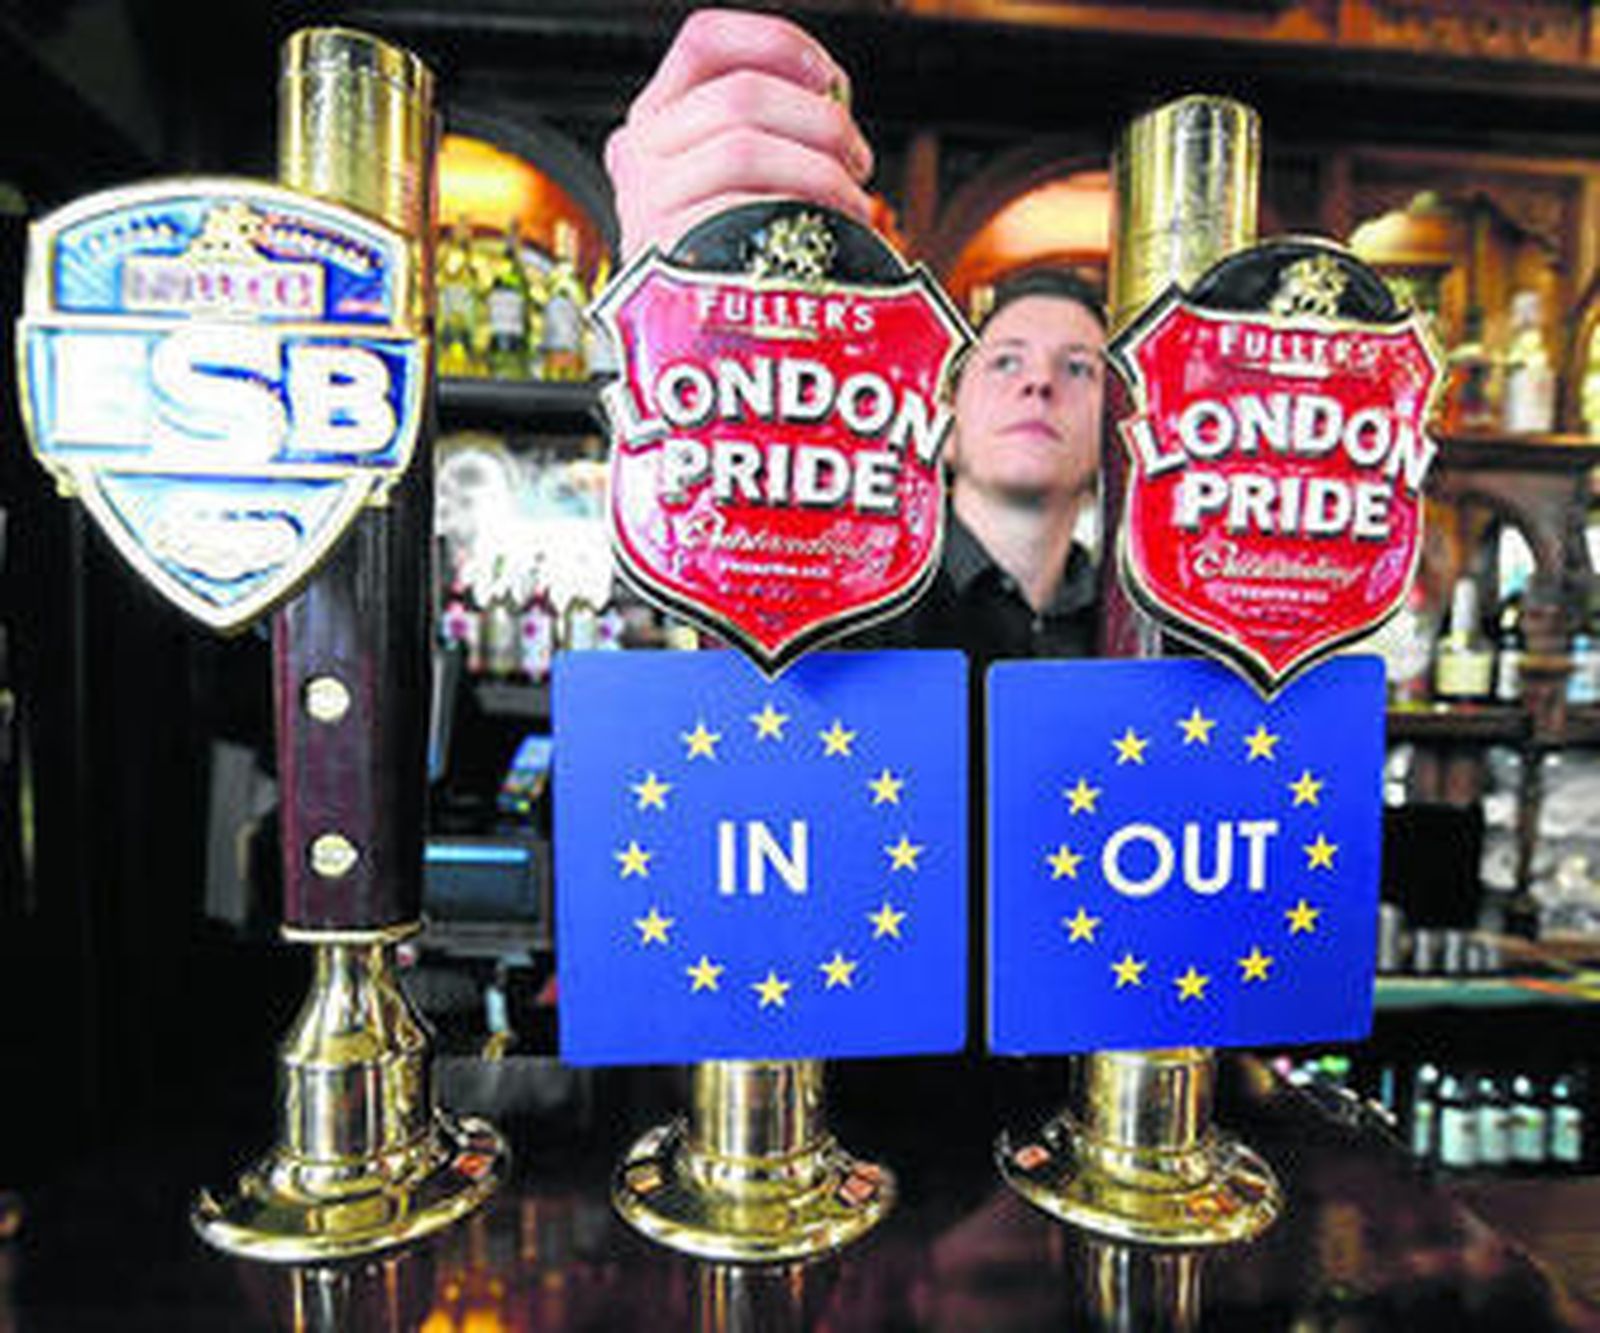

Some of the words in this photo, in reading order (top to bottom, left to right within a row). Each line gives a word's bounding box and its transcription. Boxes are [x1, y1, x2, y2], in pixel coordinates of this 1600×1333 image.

[603, 357, 952, 464] LONDON
[1133, 397, 1437, 493] LONDON
[661, 441, 902, 512] PRIDE
[1174, 473, 1394, 540] PRIDE
[716, 821, 809, 896] IN
[1101, 821, 1278, 898] OUT
